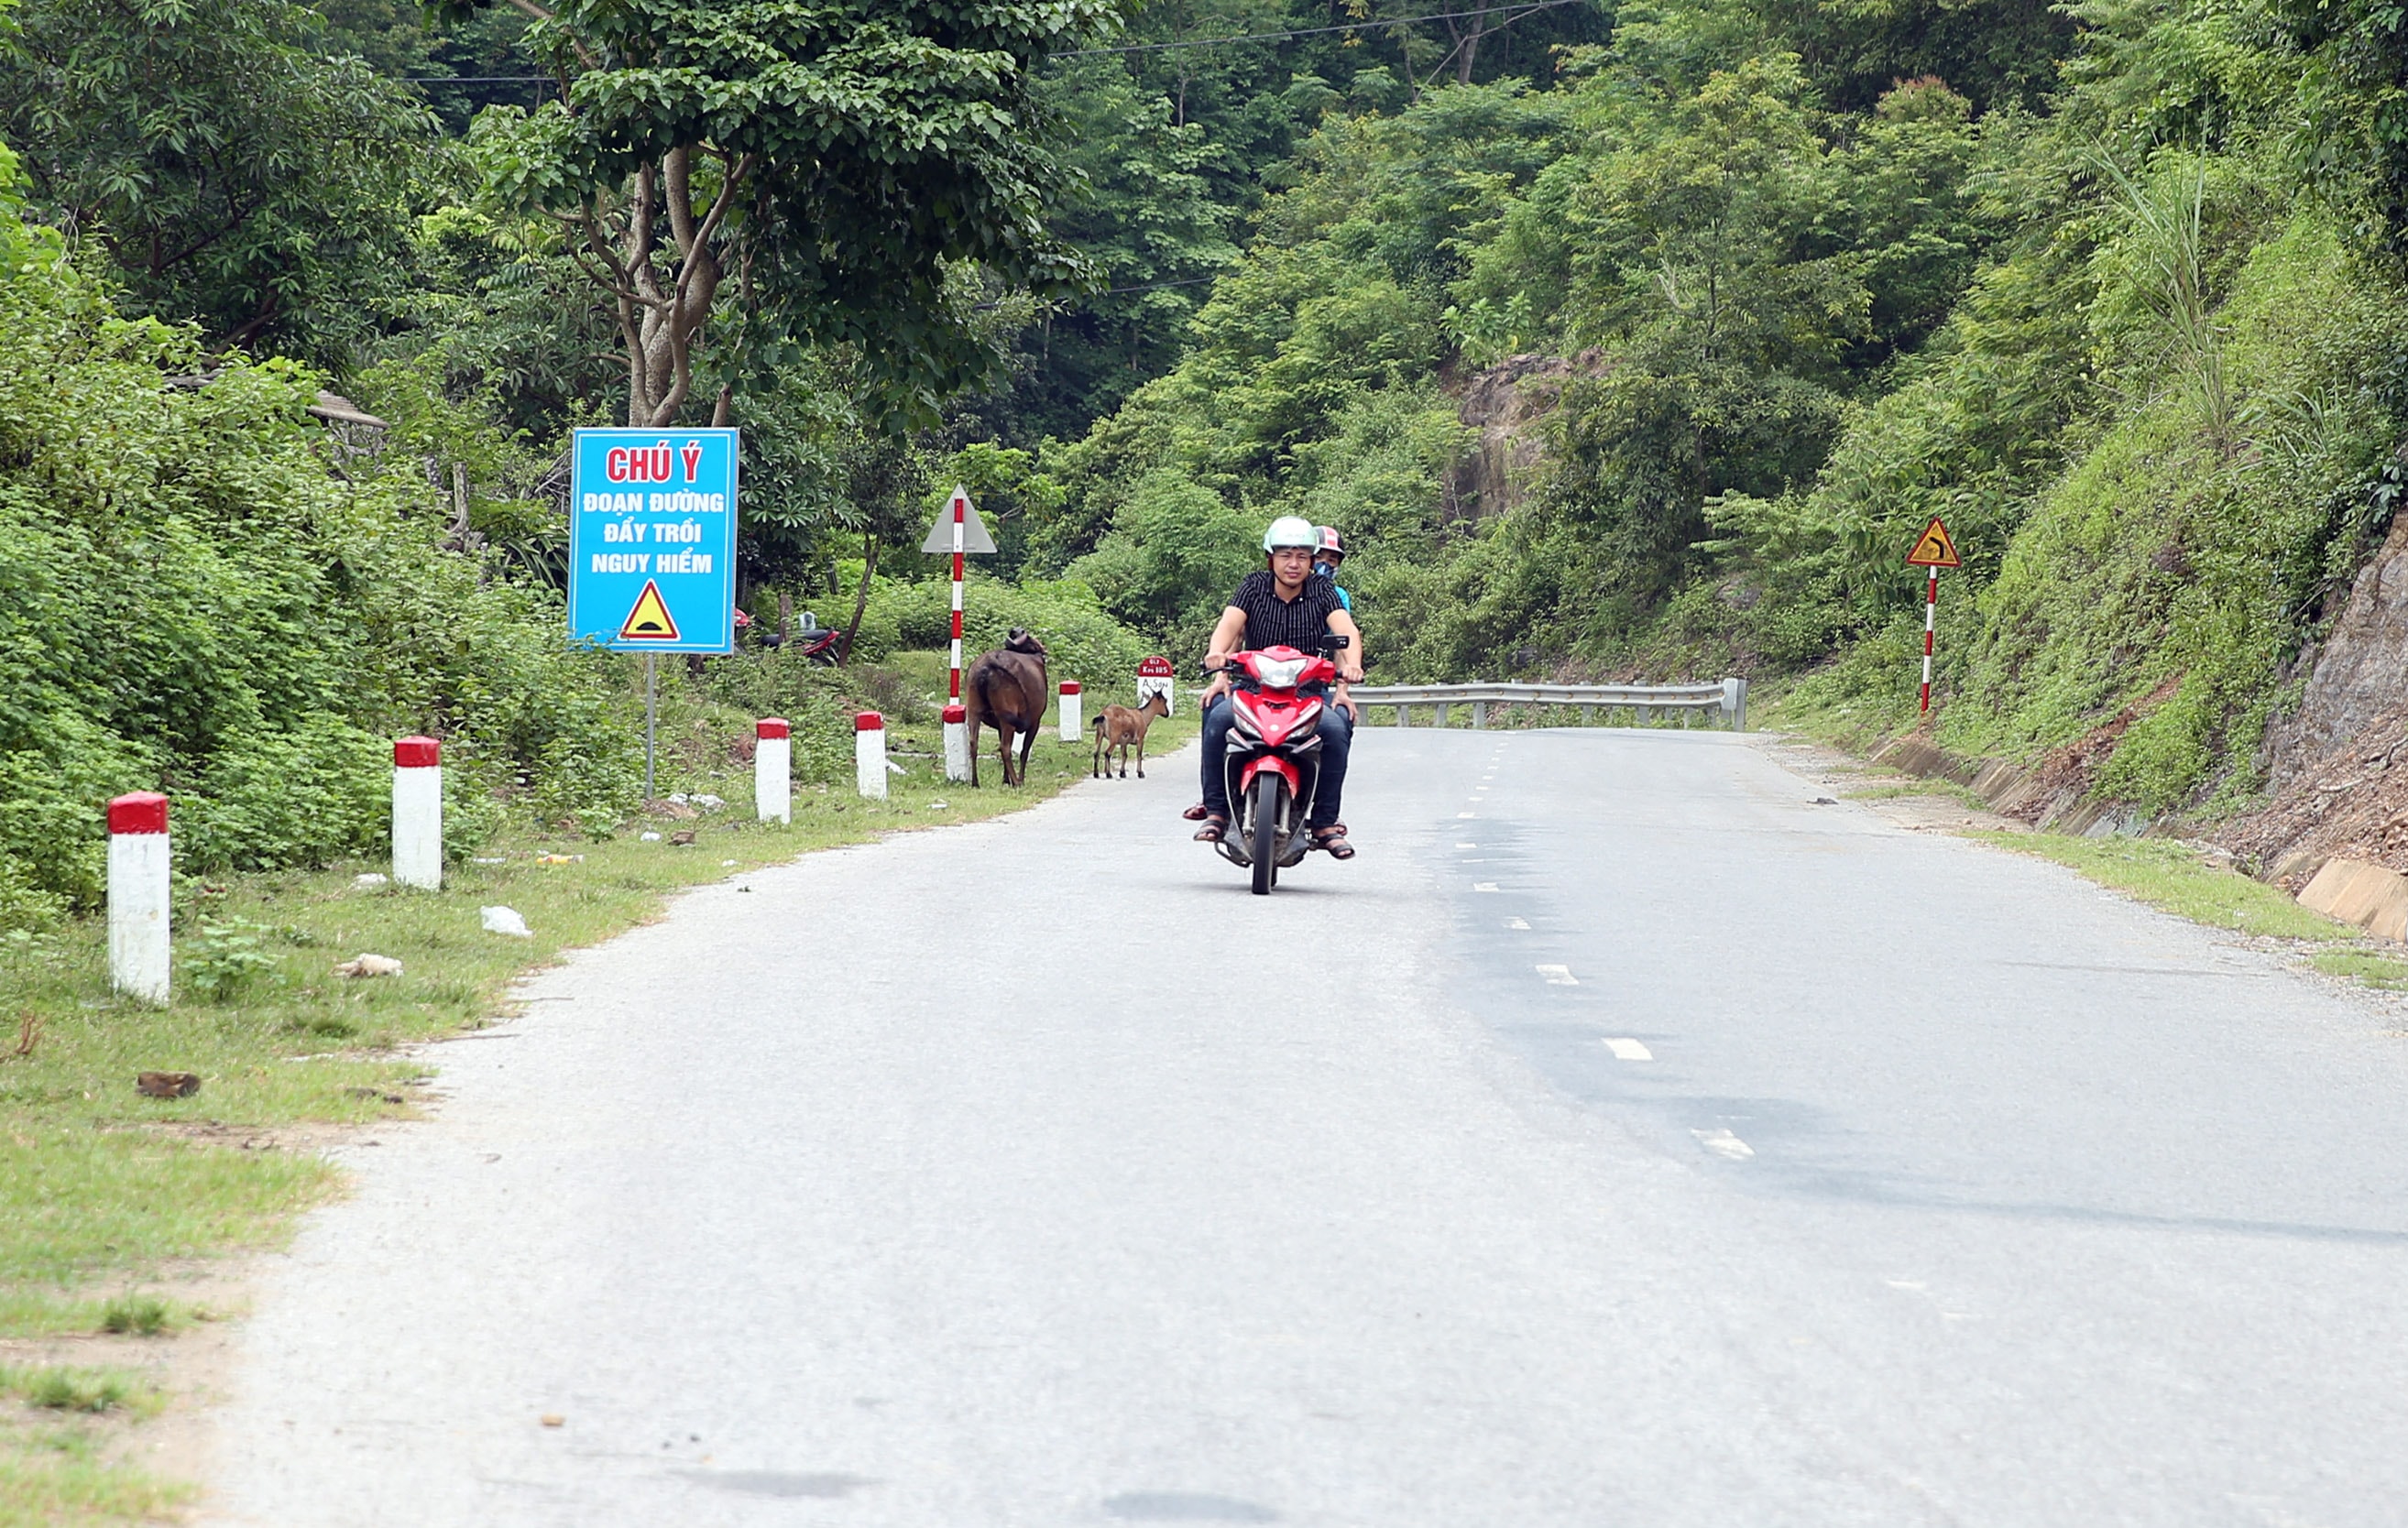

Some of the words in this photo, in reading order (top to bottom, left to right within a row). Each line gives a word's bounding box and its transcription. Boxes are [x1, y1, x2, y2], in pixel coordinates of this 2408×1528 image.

[607, 440, 673, 483] CHÚ
[679, 440, 703, 483] Ý
[583, 492, 643, 517] ĐOẠN
[649, 487, 725, 513] ĐƯỜNG
[604, 516, 648, 542] ĐẨY
[591, 553, 651, 573] NGUY
[656, 546, 713, 573] HIỂM
